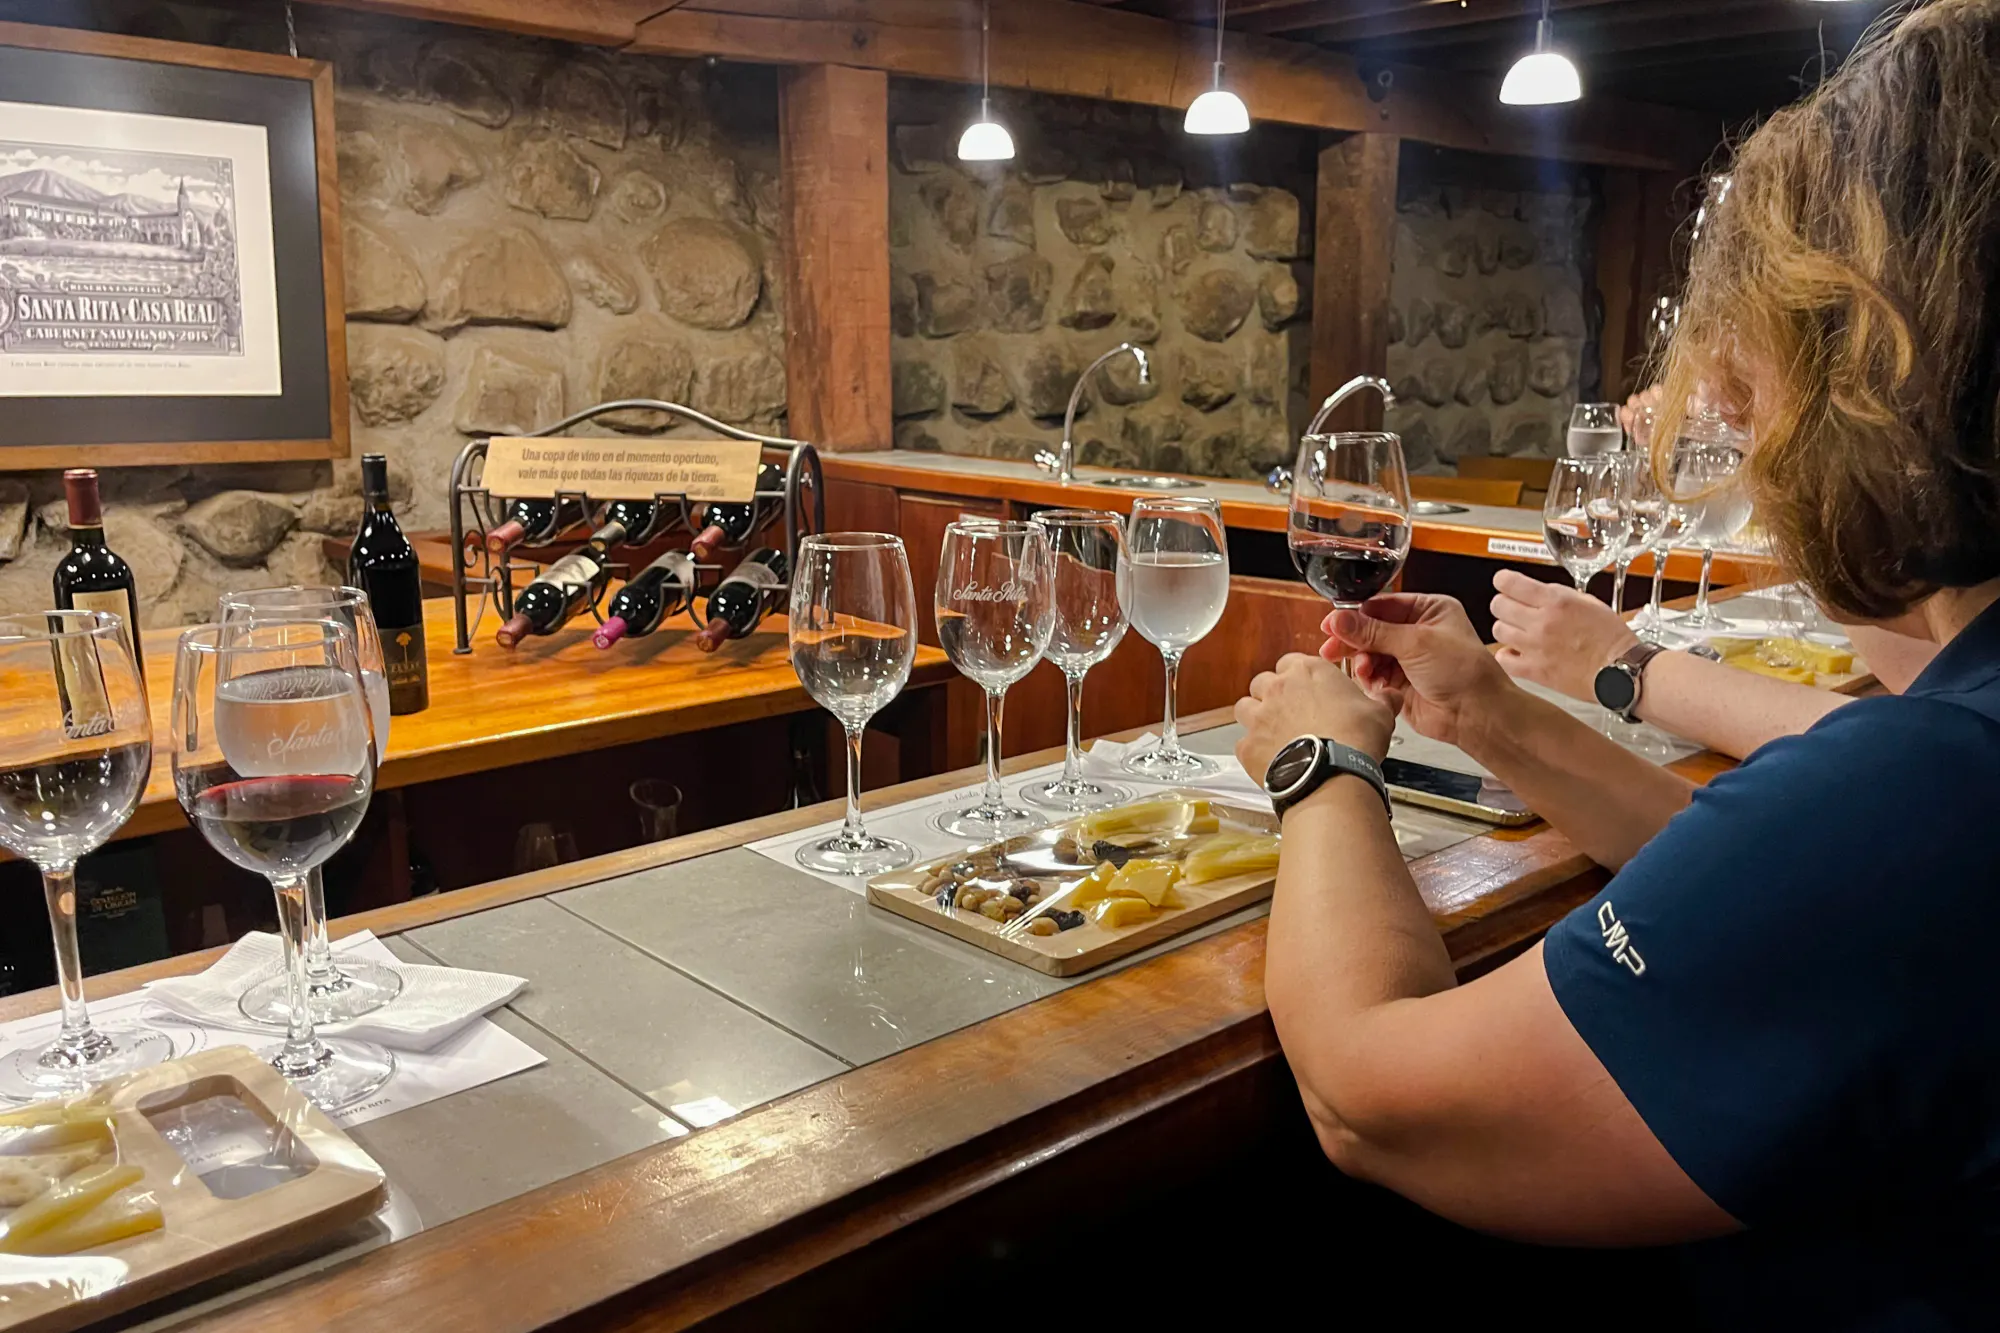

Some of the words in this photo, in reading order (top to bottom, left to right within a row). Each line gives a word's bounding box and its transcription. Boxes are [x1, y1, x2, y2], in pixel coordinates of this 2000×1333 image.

[18, 294, 76, 320] SANTA
[78, 296, 121, 321] RITA
[127, 298, 171, 323] CASA
[174, 299, 216, 324] REAL
[26, 327, 98, 339] CABERNET
[100, 329, 175, 341] SAUVIGNON
[522, 448, 540, 461] Una
[543, 451, 565, 463] copa
[567, 450, 579, 461] de
[582, 450, 600, 461] vino
[602, 452, 614, 462] en
[616, 450, 625, 462] el
[627, 452, 671, 463] momento
[673, 452, 719, 466] oportuno,
[518, 468, 537, 479] vale
[539, 467, 559, 480] más
[561, 469, 578, 482] que
[581, 469, 606, 480] todas
[609, 469, 623, 481] las
[625, 470, 664, 484] riquezas
[666, 470, 678, 482] de
[680, 470, 689, 482] la
[691, 471, 719, 483] tierra.
[953, 581, 993, 601] Santa
[993, 581, 1028, 603] Rita
[267, 719, 332, 764] Santa
[1597, 900, 1647, 976] CMP
[332, 1106, 366, 1119] SANTA
[367, 1098, 391, 1109] RITA
